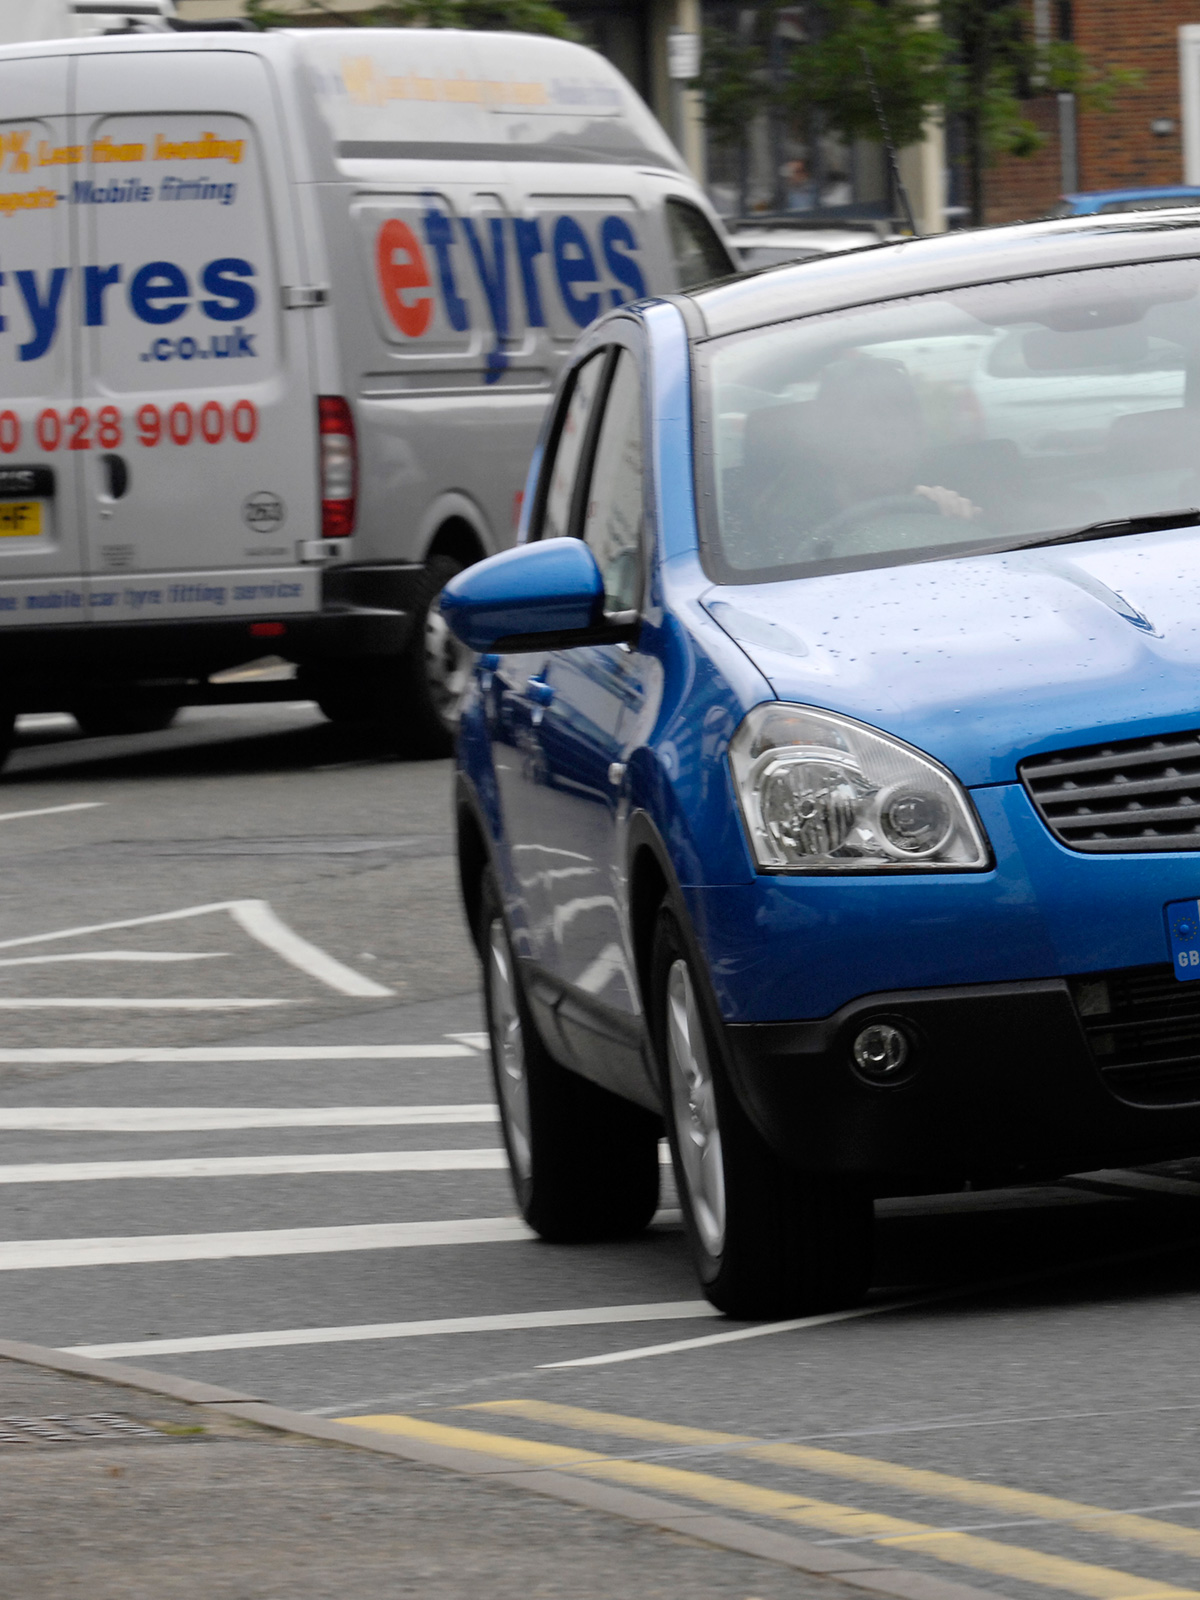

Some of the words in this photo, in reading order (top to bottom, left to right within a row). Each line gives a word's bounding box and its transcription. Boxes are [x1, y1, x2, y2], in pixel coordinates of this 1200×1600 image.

[0, 258, 258, 362] yres
[375, 188, 647, 385] etyres
[139, 326, 258, 362] .co.uk
[36, 405, 122, 452] 028
[137, 399, 259, 447] 9000
[1178, 950, 1200, 967] GB
